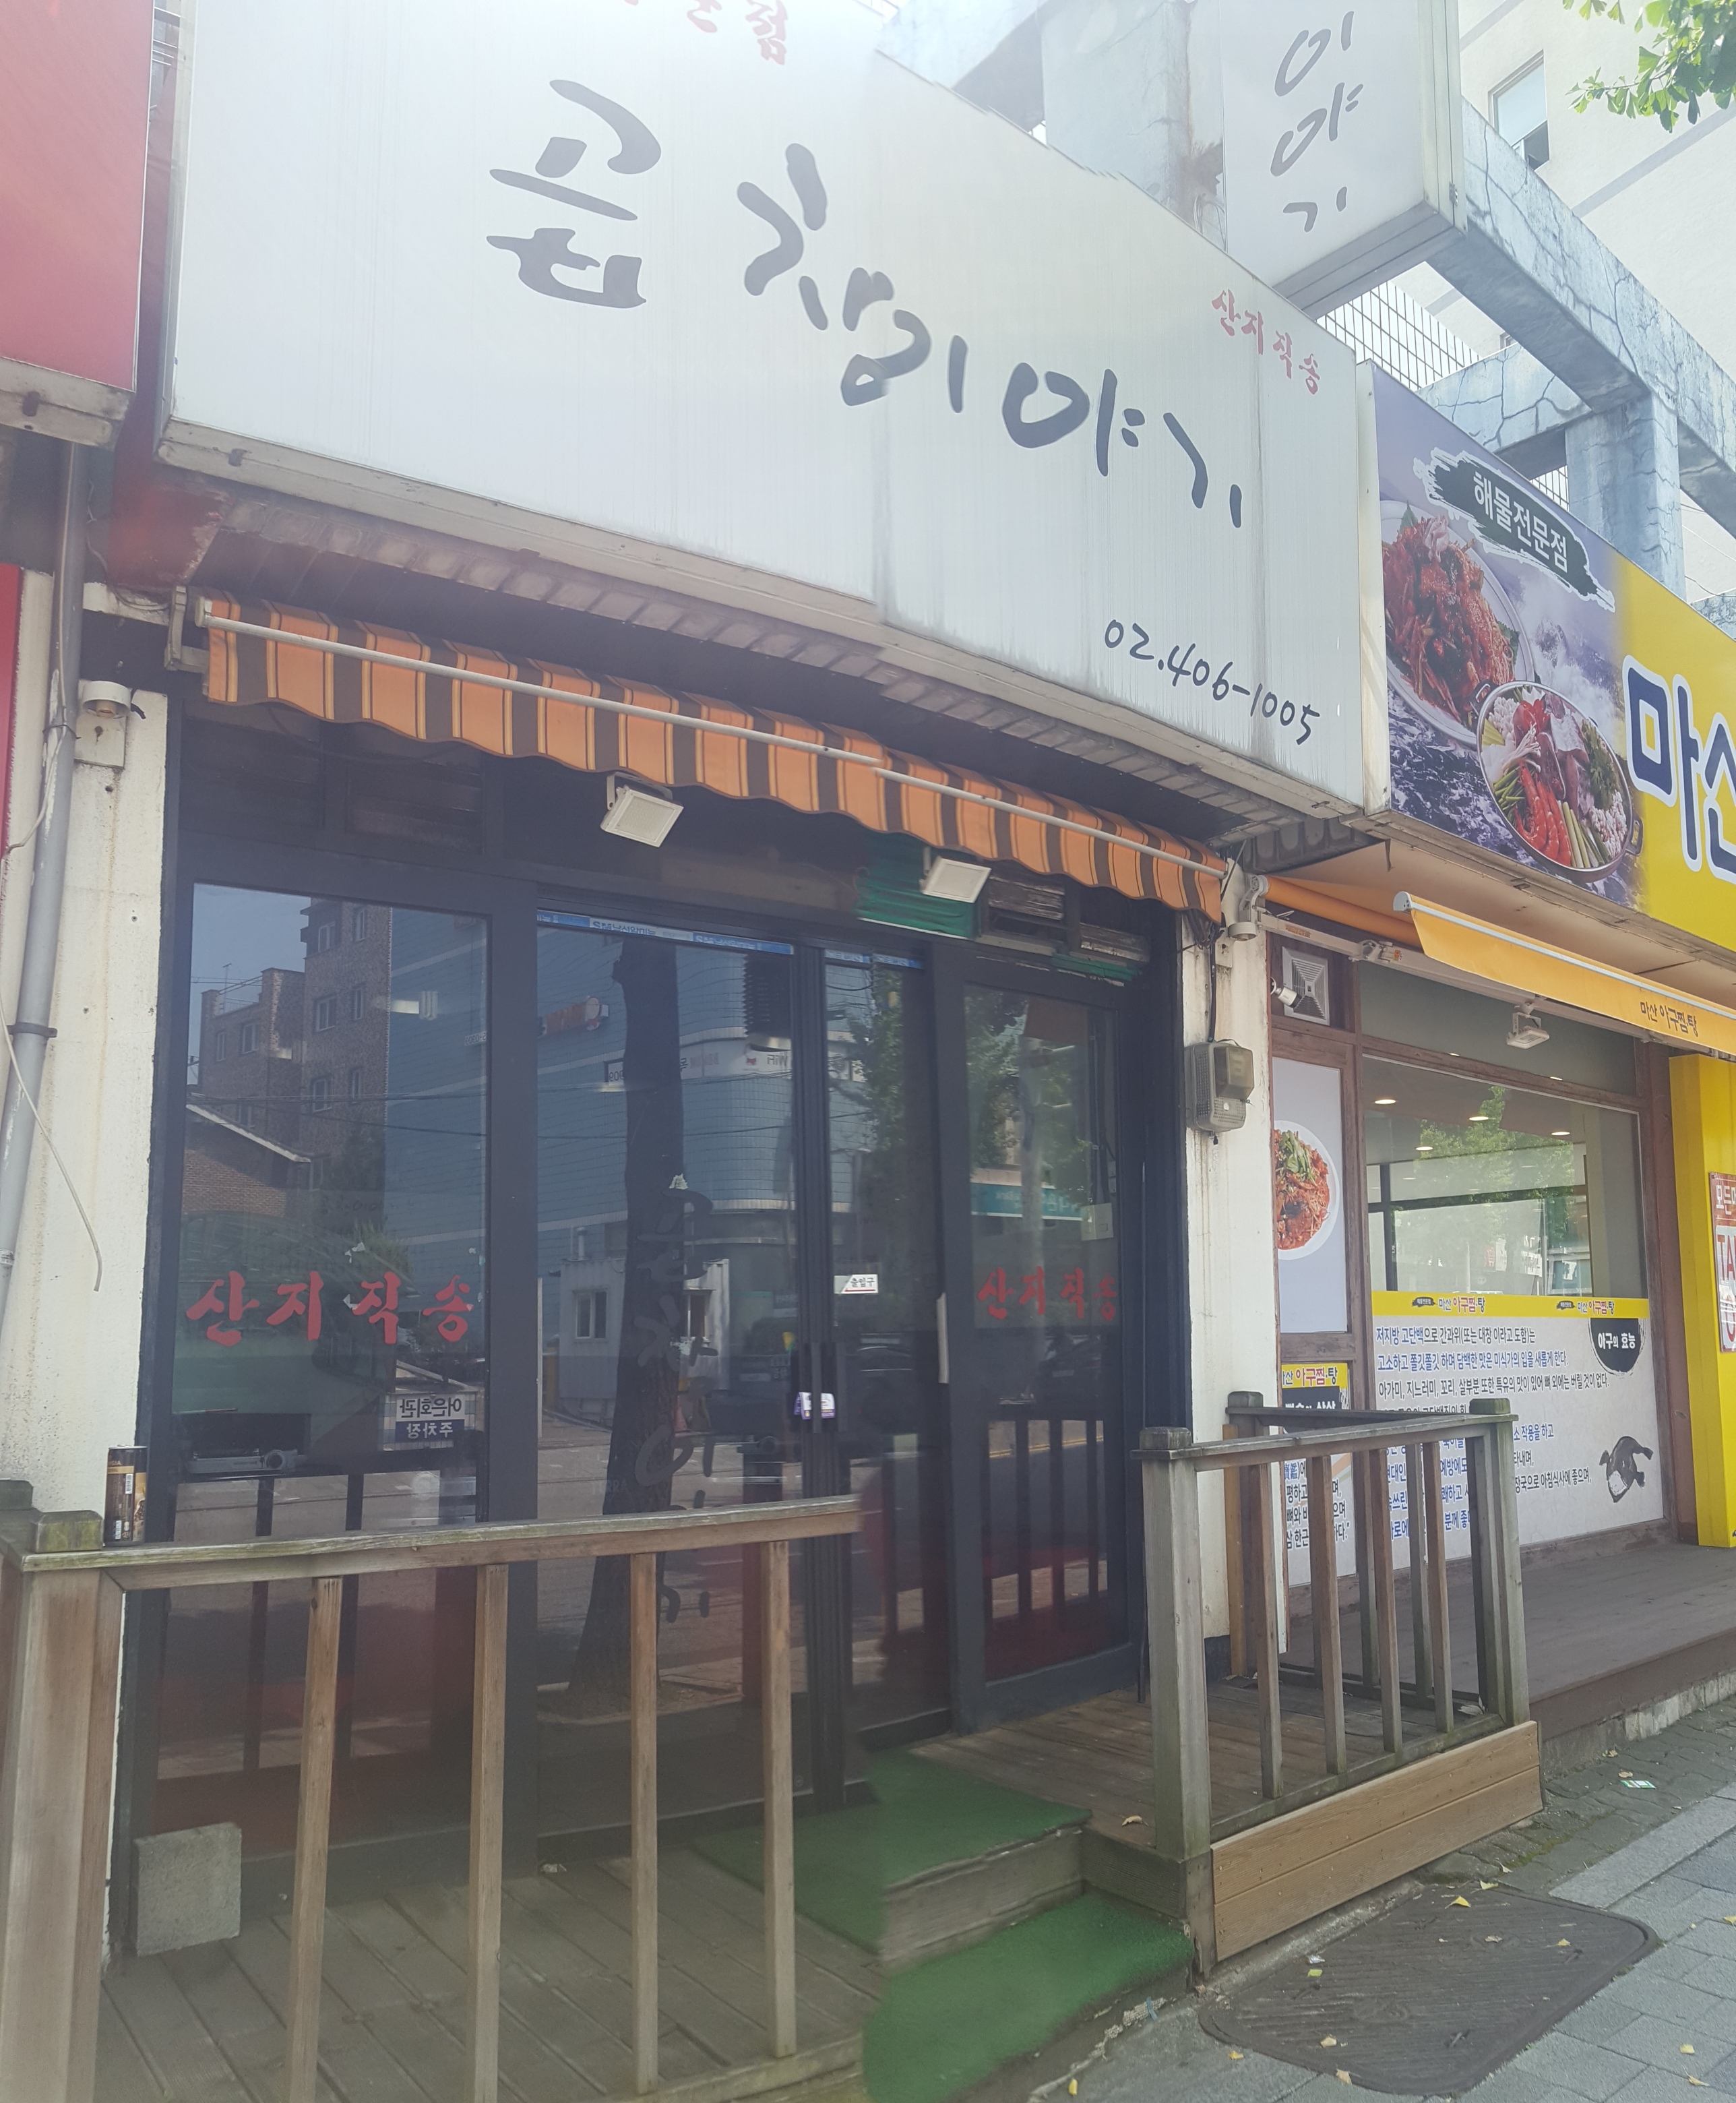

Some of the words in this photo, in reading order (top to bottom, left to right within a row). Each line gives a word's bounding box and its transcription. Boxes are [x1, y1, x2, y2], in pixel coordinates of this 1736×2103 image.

[1211, 288, 1320, 395] 산지직송
[1473, 472, 1569, 574] 해물전문점
[1105, 619, 1320, 745] 02.406-1005
[1640, 1001, 1658, 1023] 마산
[977, 1266, 1117, 1321] 산지직송
[1438, 1298, 1452, 1311] 마산
[186, 1271, 474, 1347] 산지직송
[1578, 1302, 1588, 1313] 마산
[1376, 1327, 1400, 1345] 저지방
[1402, 1327, 1439, 1345] 고단백으로
[1440, 1327, 1477, 1345] 간과위(또는
[1479, 1327, 1492, 1345] 대창
[1493, 1327, 1512, 1344] 이라고
[1514, 1327, 1536, 1344] 도함)는
[1598, 1333, 1619, 1349] 아구의
[1621, 1333, 1636, 1349] 효능
[1377, 1353, 1408, 1372] 고소하고
[1410, 1352, 1439, 1372] 쫄깃쫄깃
[1441, 1352, 1456, 1370] 하며
[1457, 1351, 1478, 1370] 담백한
[1479, 1351, 1493, 1370] 맛은
[1494, 1351, 1519, 1369] 미식가의
[1521, 1350, 1534, 1368] 입을
[1535, 1350, 1553, 1368] 새롭게
[1554, 1349, 1568, 1367] 한다.
[1379, 1380, 1405, 1401] 아가미,
[1406, 1378, 1439, 1399] 지느러미,
[1441, 1378, 1458, 1397] 꼬리,
[1459, 1377, 1479, 1396] 살부분
[1481, 1376, 1495, 1394] 또한
[1496, 1375, 1516, 1393] 특유의
[1517, 1375, 1530, 1392] 맛이
[1531, 1374, 1543, 1391] 있어
[1552, 1373, 1570, 1391] 외에는
[1571, 1372, 1582, 1390] 버릴
[1583, 1372, 1595, 1389] 것이
[1596, 1372, 1609, 1389] 없다.
[1521, 1424, 1541, 1442] 작용을
[1541, 1423, 1554, 1439] 하고
[1541, 1469, 1571, 1489] 아침식사에
[1572, 1467, 1591, 1486] 좋으며,
